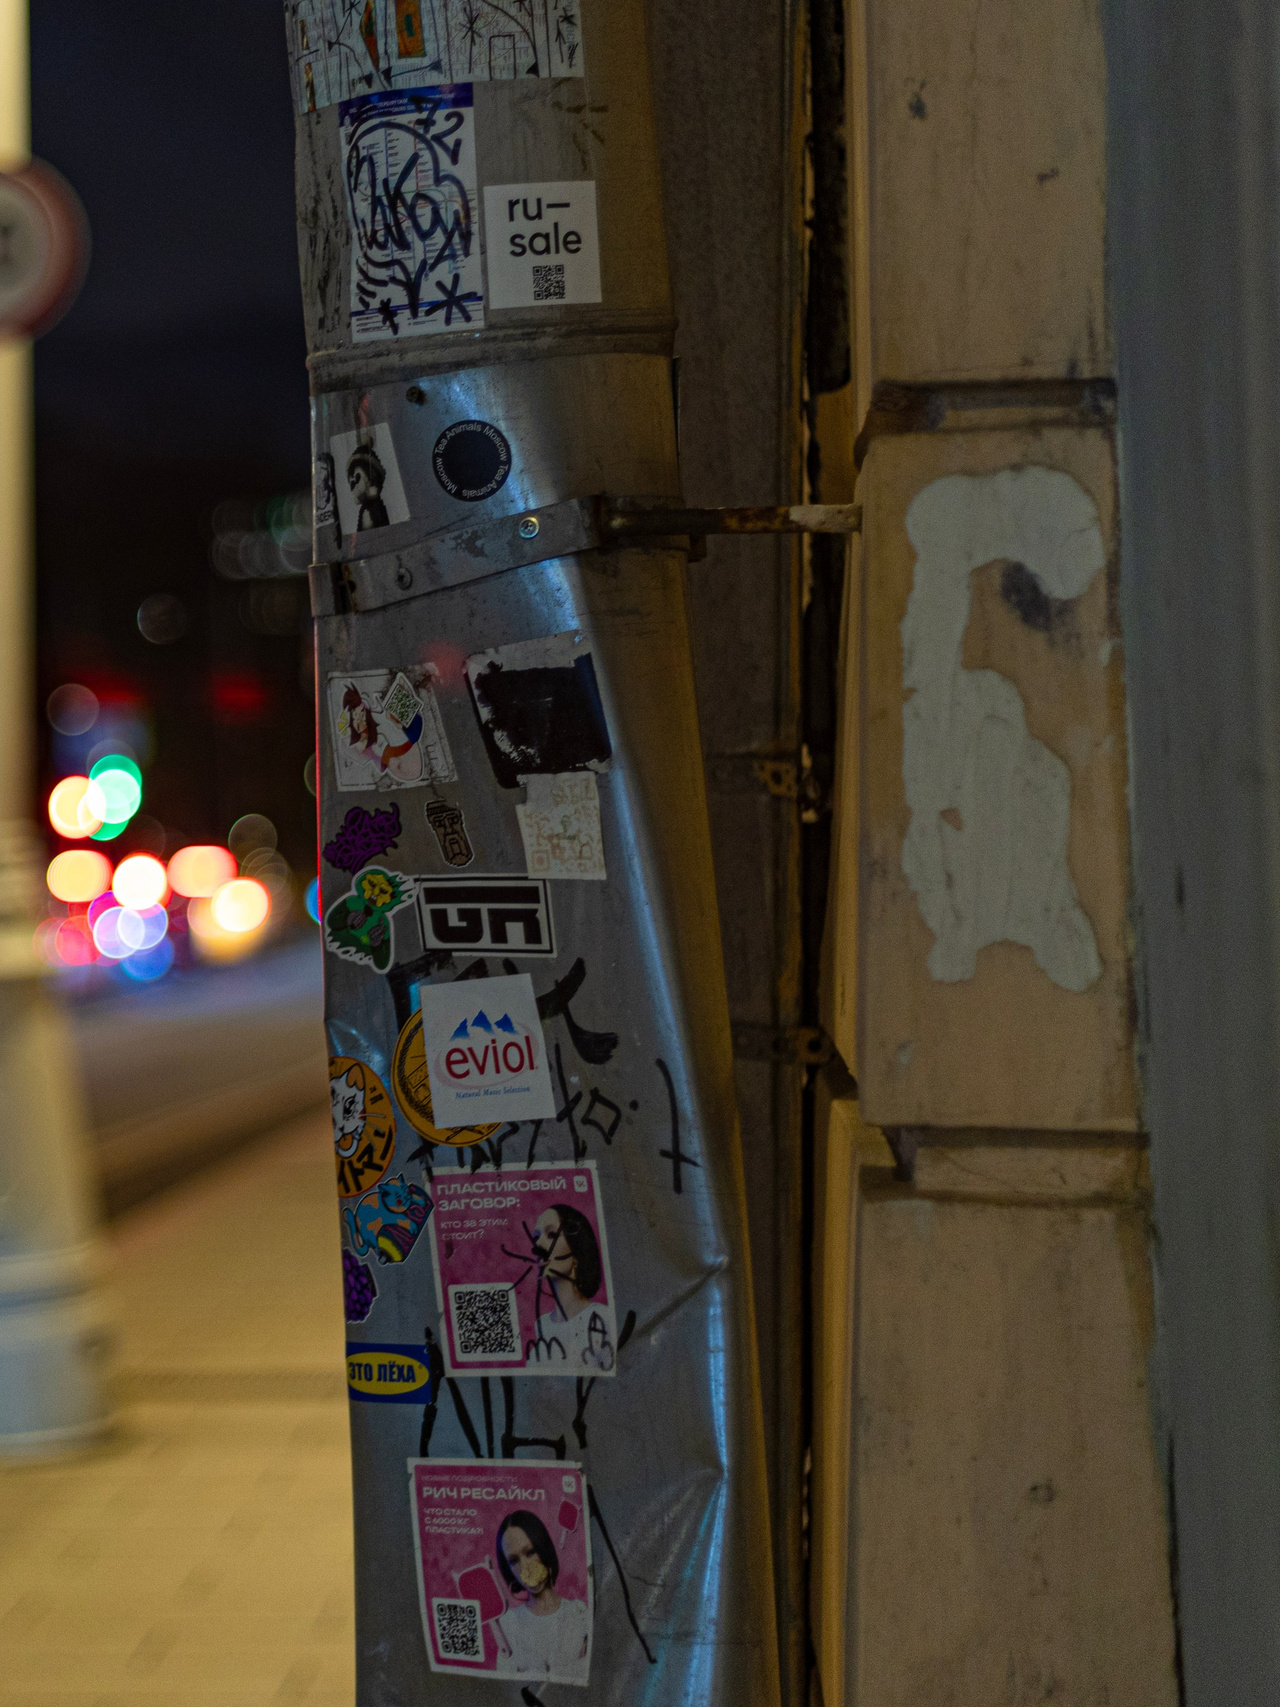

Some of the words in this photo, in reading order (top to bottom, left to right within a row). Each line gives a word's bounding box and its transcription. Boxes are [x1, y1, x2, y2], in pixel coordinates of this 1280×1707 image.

[509, 222, 582, 256] sale
[445, 421, 482, 439] Animals
[434, 438, 448, 454] Tea
[482, 425, 508, 462] Moscow
[434, 456, 458, 494] Moscow
[495, 464, 510, 481] Tea
[461, 479, 498, 499] Animals
[445, 1035, 535, 1080] eviol
[455, 1089, 482, 1100] Natural
[483, 1088, 502, 1097] Music
[503, 1085, 530, 1096] Selection
[436, 1175, 566, 1195] ПЛАСТИКОВЫЙ
[438, 1196, 520, 1211] ЗАГОВОР:
[441, 1220, 462, 1228] КТО
[479, 1218, 508, 1226] ЭТИМ
[442, 1228, 484, 1240] СТОИТ?
[347, 1361, 372, 1382] ЭТО
[376, 1359, 416, 1383] ЛЁХА
[423, 1486, 458, 1498] РИЧ
[461, 1485, 544, 1500] РЕСАЙКЛ
[424, 1507, 443, 1515] ЧТО
[444, 1507, 477, 1516] СТАЛО
[425, 1516, 432, 1524] С
